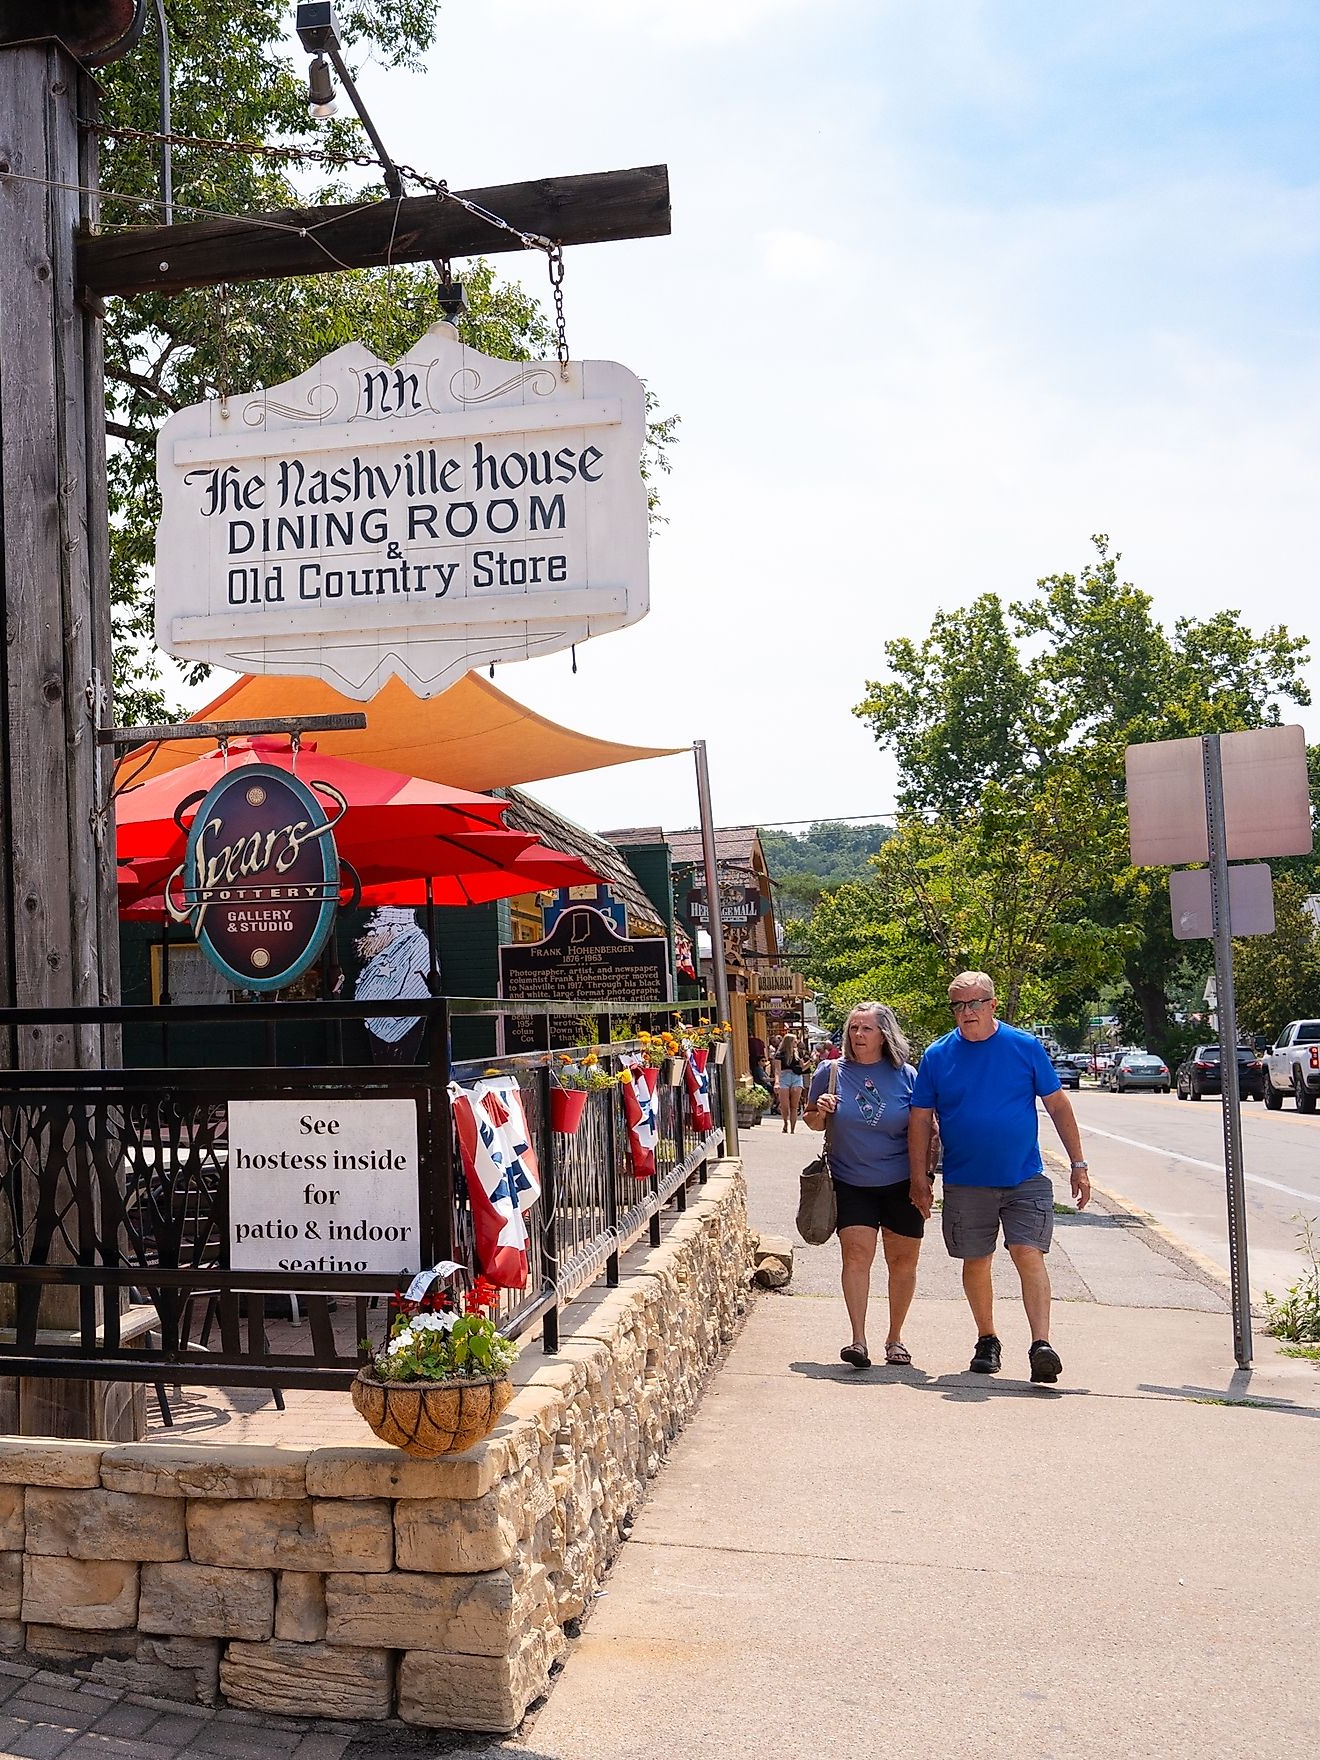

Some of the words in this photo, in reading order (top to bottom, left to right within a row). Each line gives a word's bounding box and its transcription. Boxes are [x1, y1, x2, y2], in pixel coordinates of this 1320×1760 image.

[182, 467, 265, 517] The
[277, 447, 462, 509] Nashville
[473, 441, 605, 493] house
[227, 506, 388, 555] DINING
[407, 493, 566, 541] ROOM
[386, 541, 404, 560] &
[227, 567, 284, 605] Old
[299, 559, 460, 601] Country
[473, 550, 568, 588] Store
[202, 886, 318, 901] POTTERY
[227, 909, 292, 921] GALLERY
[690, 902, 733, 917] HERGE
[734, 900, 757, 917] MALL
[227, 922, 238, 933] &
[239, 920, 294, 933] STUDIO
[509, 976, 548, 985] columnist
[550, 975, 574, 984] Frank
[576, 973, 630, 984] Hohenberger
[632, 971, 659, 980] moved
[597, 966, 613, 974] and
[614, 965, 659, 974] newspaper
[508, 984, 518, 992] to
[519, 983, 556, 992] Nashville
[557, 982, 566, 990] in
[586, 980, 623, 990] Through
[623, 979, 638, 988] his
[639, 978, 661, 988] black
[508, 991, 525, 999] and
[553, 990, 575, 1000] large
[576, 989, 605, 997] format
[299, 1115, 341, 1135] See
[236, 1148, 327, 1170] hostess
[333, 1149, 407, 1170] inside
[303, 1183, 341, 1205] for
[235, 1219, 298, 1243] patio
[304, 1220, 322, 1240] &
[328, 1219, 412, 1241] indoor
